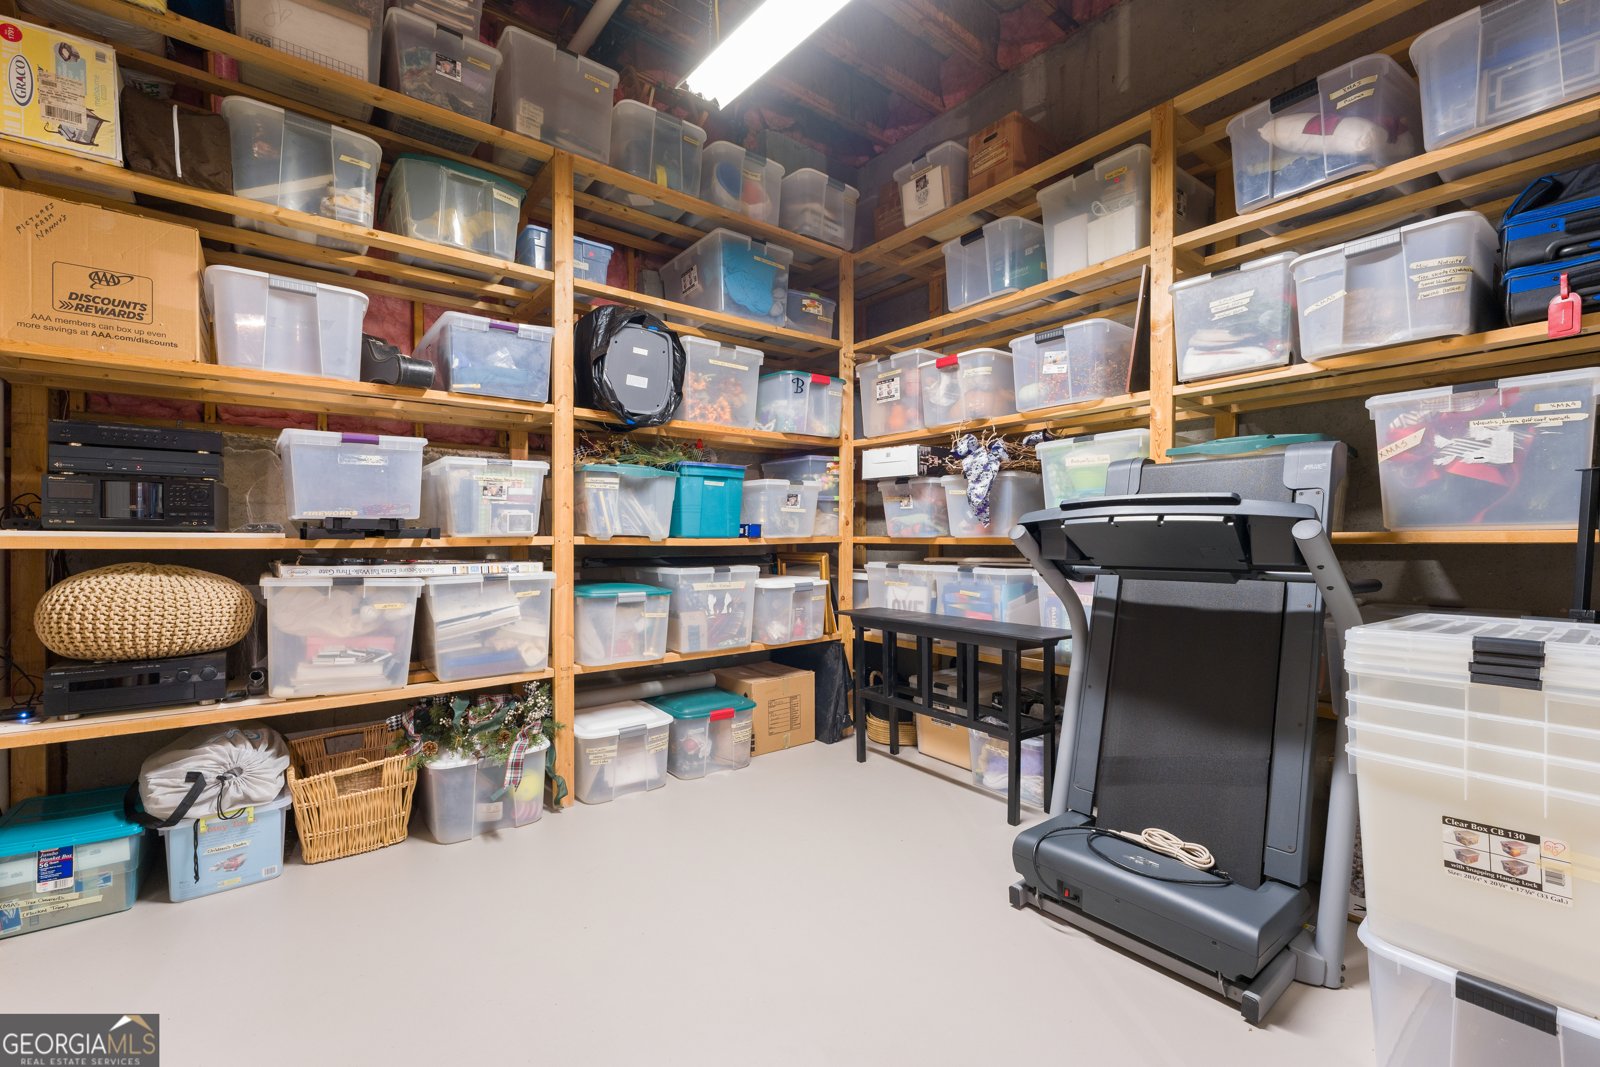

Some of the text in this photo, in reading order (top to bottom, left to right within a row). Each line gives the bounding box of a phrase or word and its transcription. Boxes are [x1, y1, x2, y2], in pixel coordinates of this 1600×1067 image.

[15, 59, 27, 100] GRACO
[16, 202, 55, 234] PICTURES
[34, 213, 54, 229] FROM
[35, 214, 67, 240] NANNY'S
[91, 271, 119, 287] AAA
[68, 291, 148, 312] DISCOUNTS
[74, 303, 145, 321] REWARDS
[16, 320, 42, 330] more
[43, 323, 78, 336] savings
[91, 330, 179, 348] AAA.com/discounts
[31, 313, 167, 338] AAA members can box up even
[791, 377, 805, 394] B
[1379, 441, 1408, 458] XMAS
[318, 568, 335, 576] Gate
[335, 568, 370, 576] Walk-Thru
[1444, 817, 1526, 841] Clear Box CB 130
[1447, 868, 1463, 878] Size:
[1550, 894, 1569, 905] Gal.)
[1450, 862, 1539, 889] with Snapping Handle Lock
